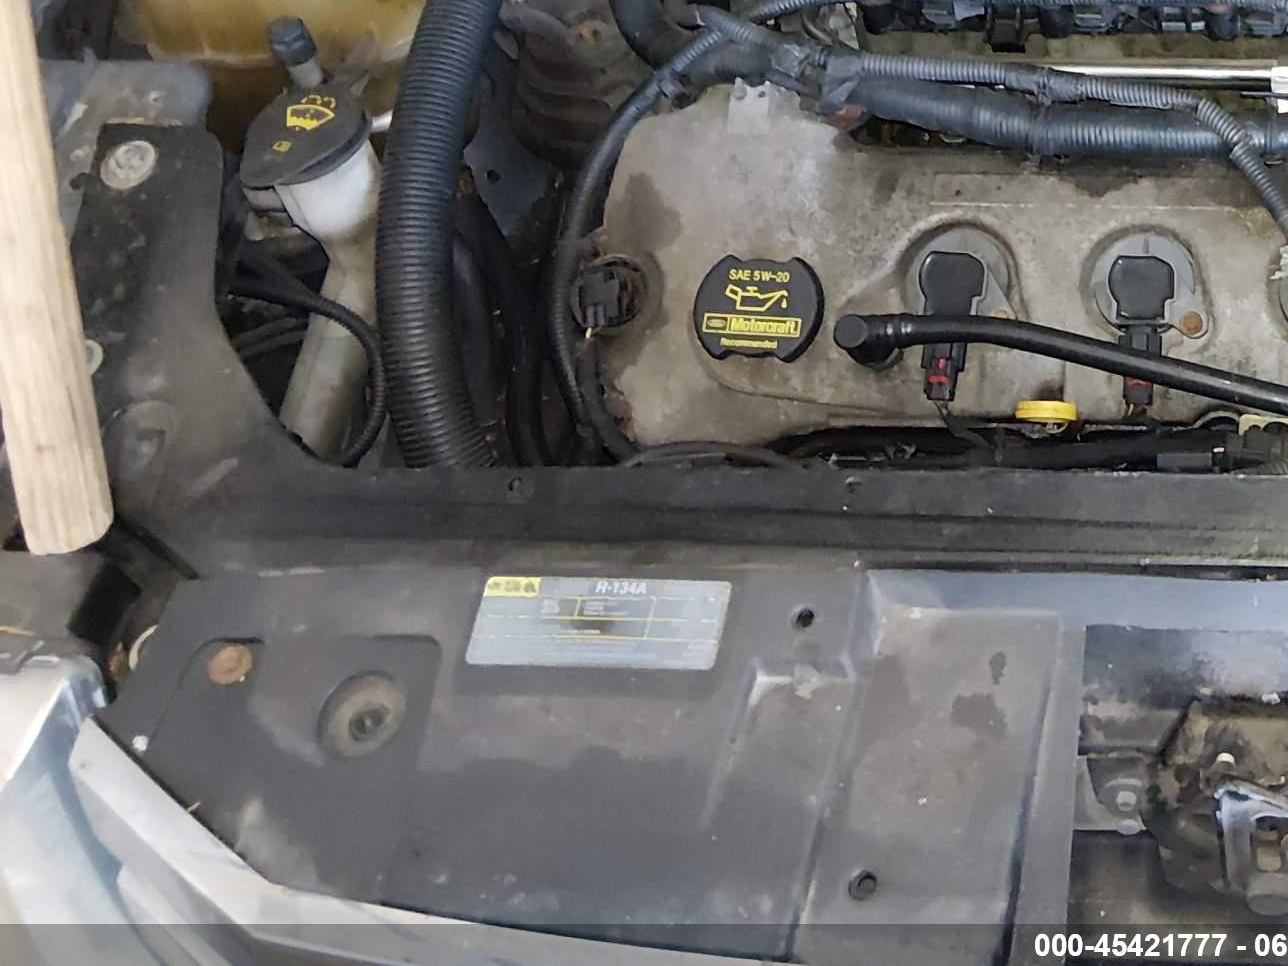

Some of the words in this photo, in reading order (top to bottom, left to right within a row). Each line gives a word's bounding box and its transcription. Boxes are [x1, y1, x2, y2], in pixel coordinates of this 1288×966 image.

[729, 269, 751, 281] SAE
[753, 269, 790, 282] 5W-20
[731, 318, 796, 334] Motorcraft
[595, 581, 647, 595] R-134A
